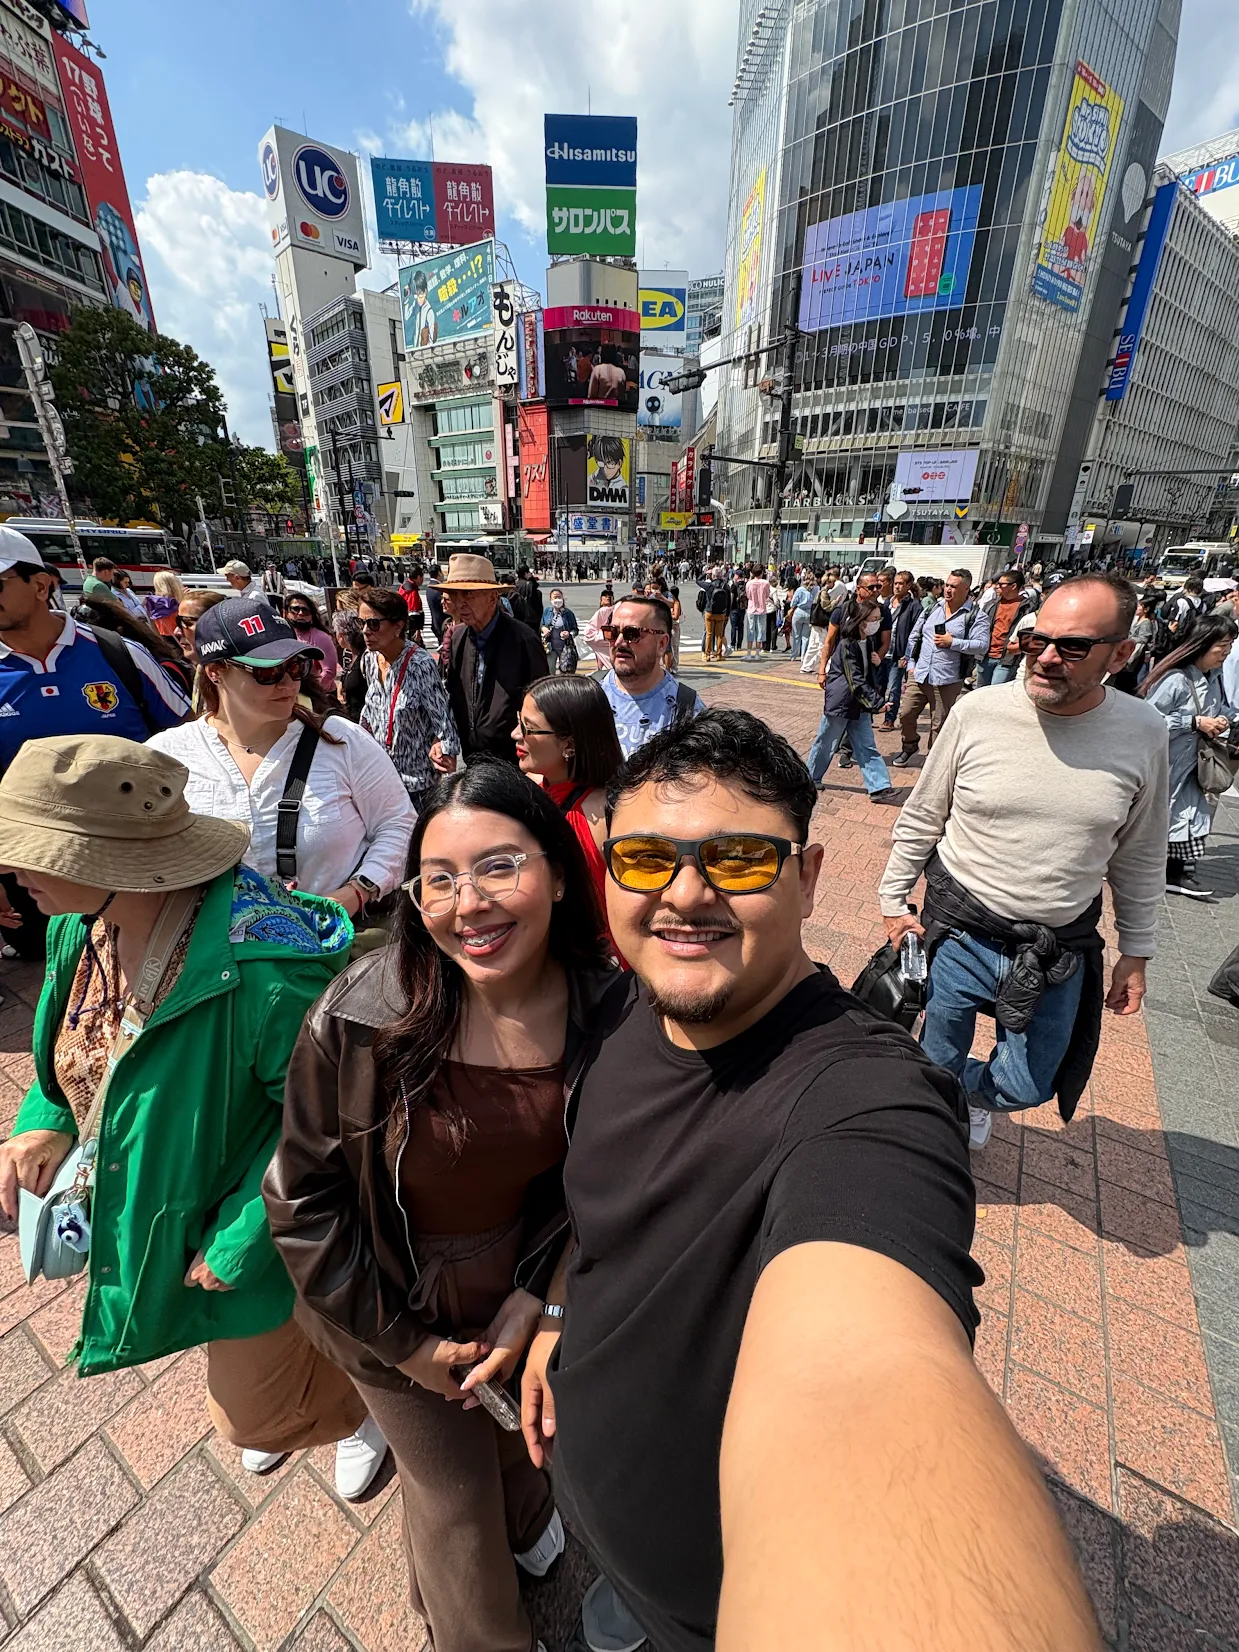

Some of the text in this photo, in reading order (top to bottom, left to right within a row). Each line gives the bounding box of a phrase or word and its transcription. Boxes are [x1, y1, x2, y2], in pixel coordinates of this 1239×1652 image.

[80, 69, 114, 173] 野球って
[31, 138, 75, 180] ガスト
[546, 142, 635, 162] Hisamitsu
[263, 151, 277, 185] UC
[300, 160, 345, 204] UC
[385, 176, 422, 198] 龍角散
[446, 180, 482, 202] 龍角散
[383, 198, 430, 220] ダイレクト
[443, 201, 490, 223] ダイレクト
[551, 206, 631, 235] サロンパス
[335, 235, 360, 252] VISA
[812, 252, 895, 284] LIVE JAPAN
[853, 275, 881, 287] TOKYO
[573, 309, 612, 323] Rakuten
[641, 300, 678, 318] EA
[493, 284, 516, 381] もんじゃ
[1108, 333, 1135, 391] SEIBU
[947, 403, 970, 412] CAFE
[589, 486, 628, 503] DMM
[782, 493, 867, 508] TARBUCKS
[561, 517, 618, 531] 大盛堂書
[238, 614, 266, 637] 11
[200, 640, 228, 656] KAVAK
